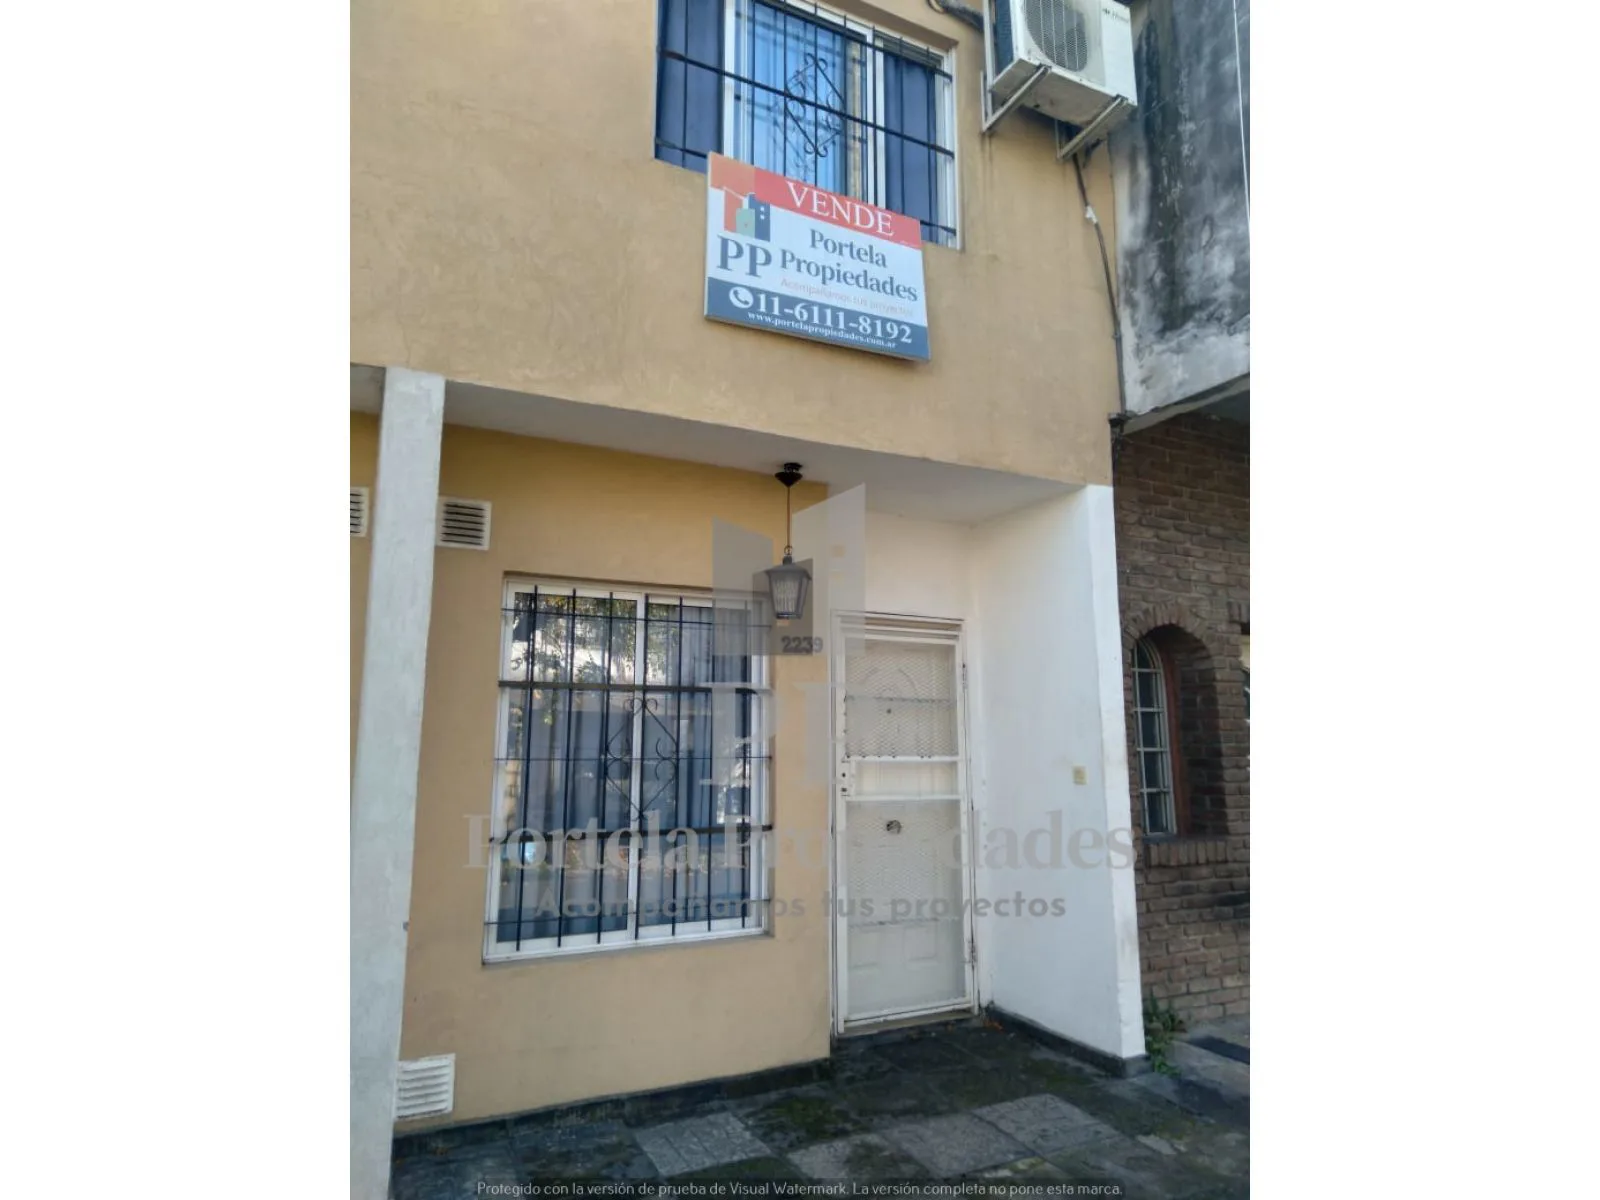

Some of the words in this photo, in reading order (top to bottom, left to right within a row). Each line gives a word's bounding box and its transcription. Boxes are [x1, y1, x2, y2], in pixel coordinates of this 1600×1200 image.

[785, 180, 894, 237] VENDE
[716, 234, 772, 279] PP
[809, 228, 887, 268] Portela
[779, 248, 918, 301] Propiedades
[747, 311, 896, 348] www.portelapropiedades.com.ar
[757, 293, 912, 344] 11-6111-8192
[781, 635, 824, 654] 2239
